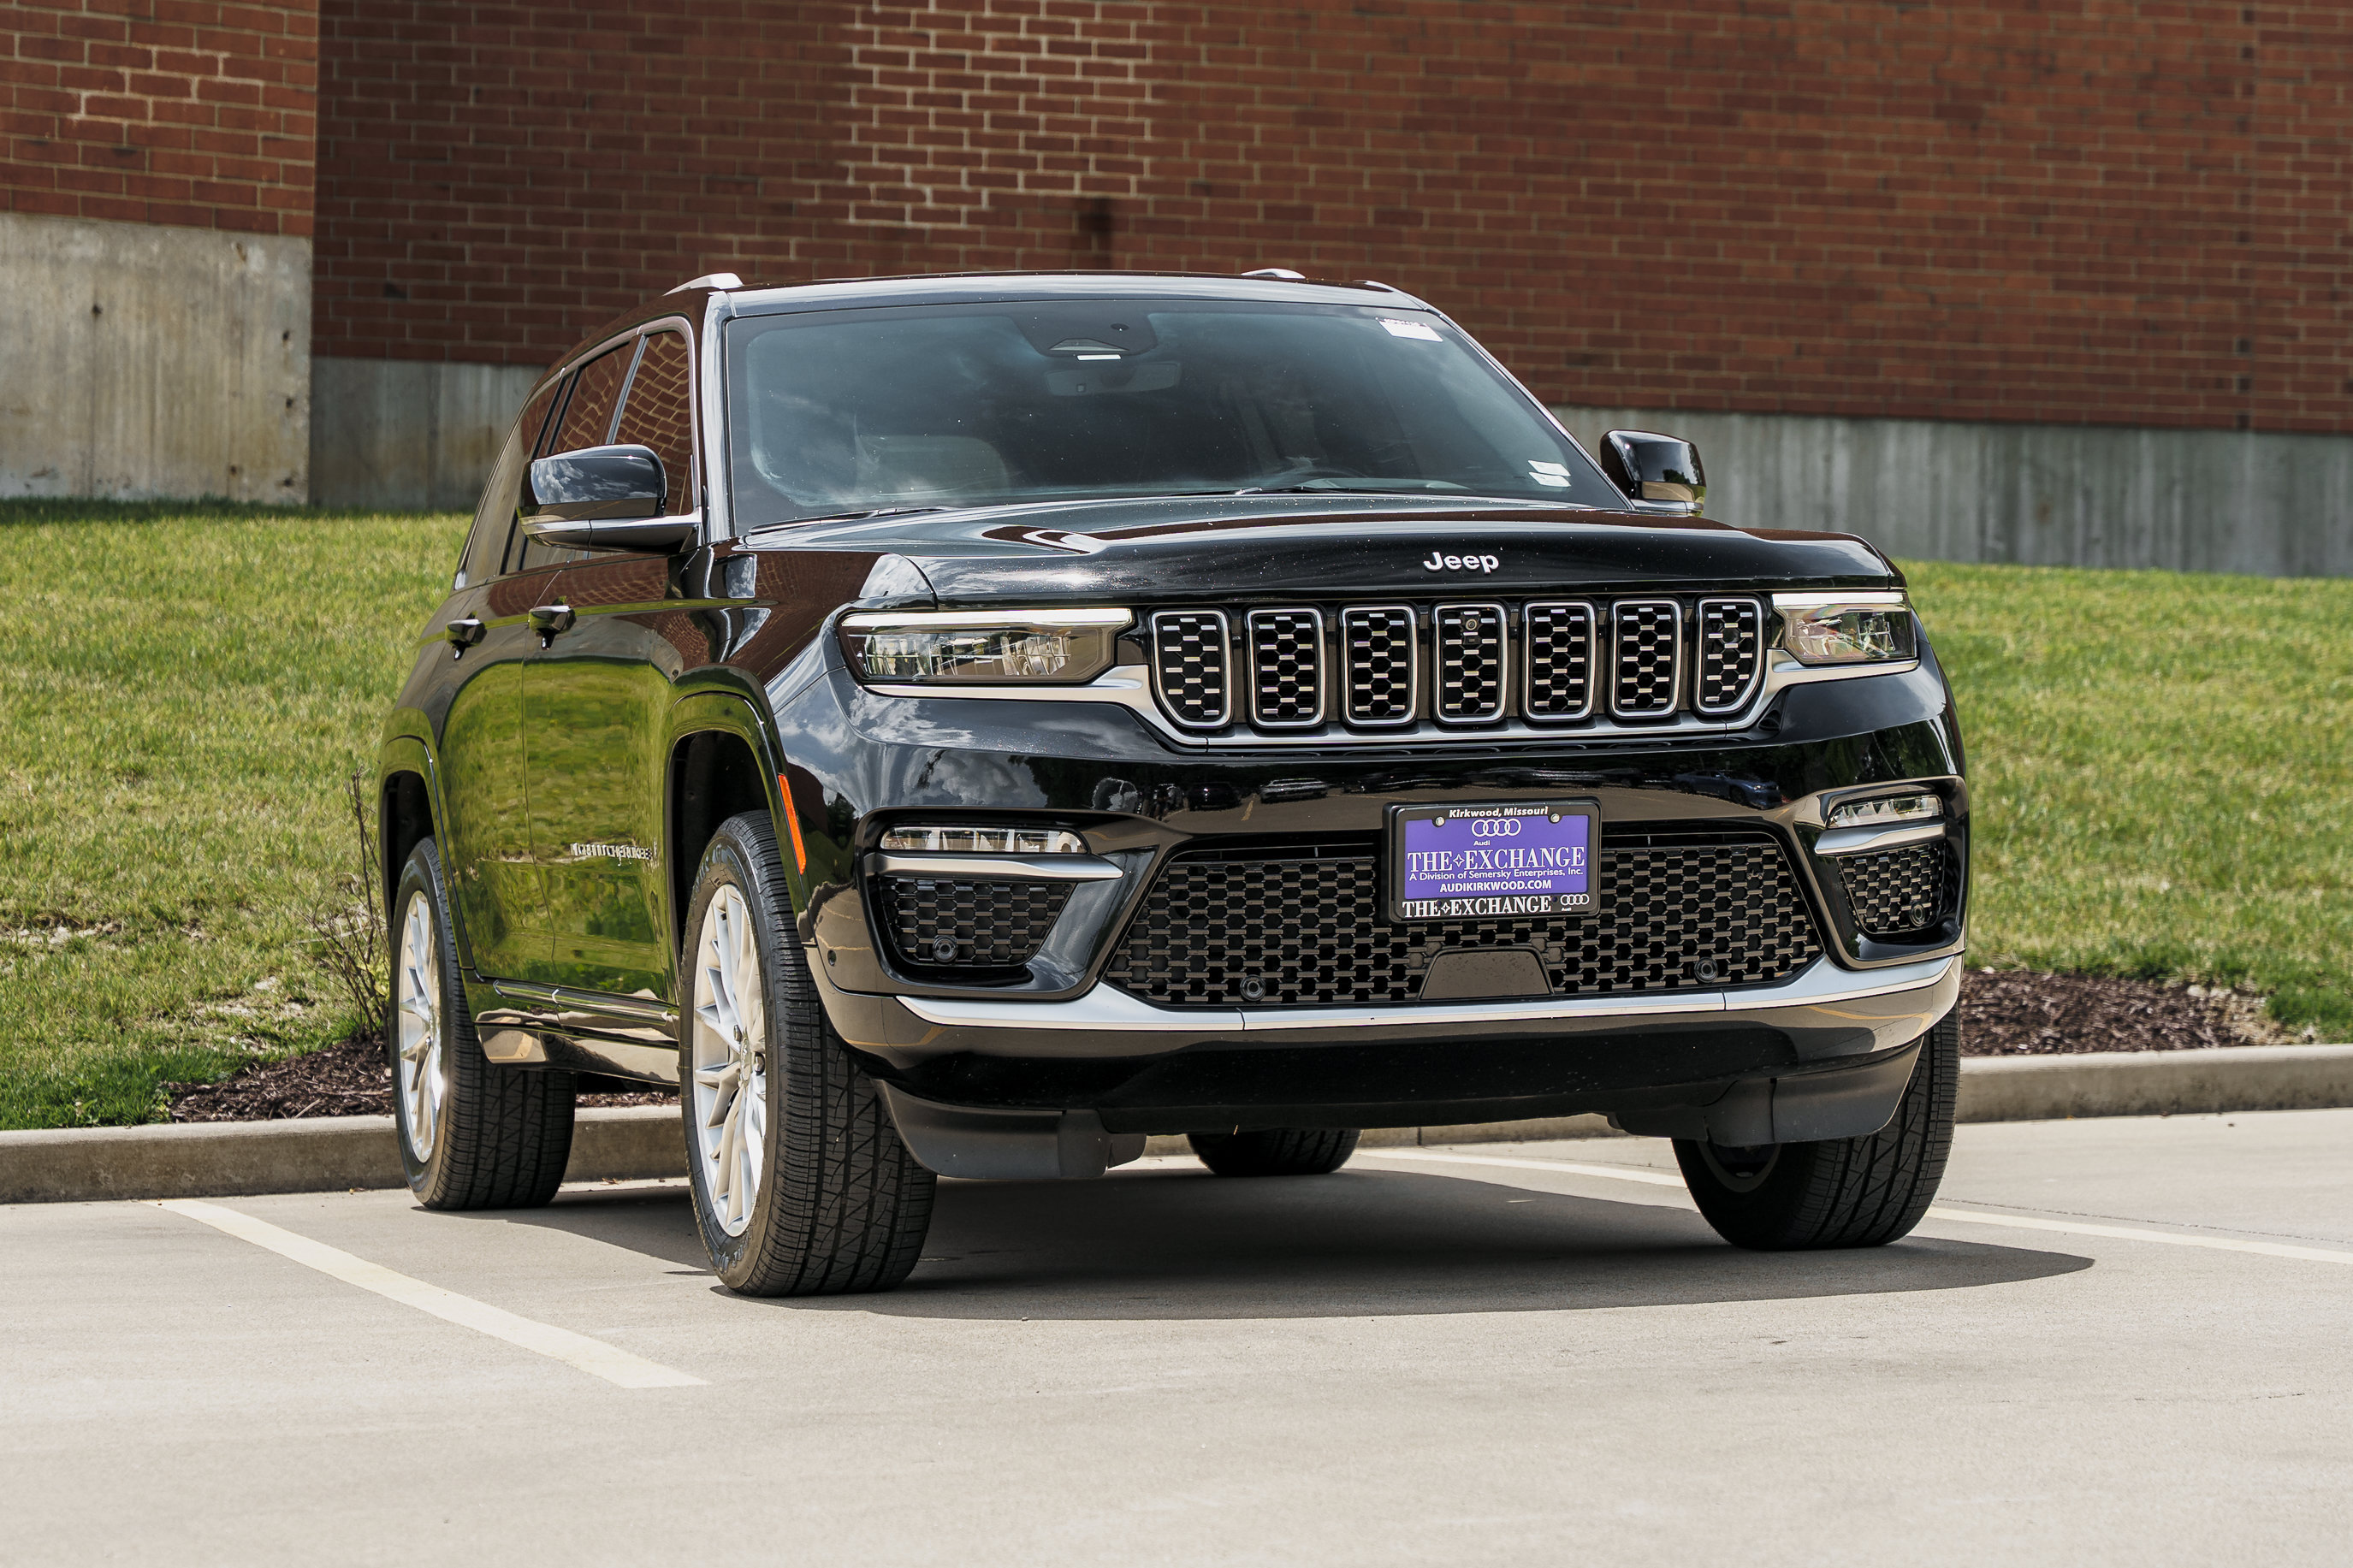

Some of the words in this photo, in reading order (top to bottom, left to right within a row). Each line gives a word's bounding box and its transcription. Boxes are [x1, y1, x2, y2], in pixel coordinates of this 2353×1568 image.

[1423, 552, 1499, 574] Jeep
[1449, 808, 1502, 819] Kirkwood,
[1503, 807, 1548, 816] Missouri
[1408, 851, 1452, 873] THE
[1464, 847, 1584, 870] EXCHANGE
[1409, 873, 1417, 881] A
[1420, 872, 1455, 880] Division
[1457, 871, 1467, 879] of
[1469, 869, 1512, 879] Semersky
[1514, 868, 1566, 879] Enterprises,
[1568, 867, 1584, 876] Inc.
[1439, 879, 1552, 893] AUDIKIRKWOOD.COM
[1402, 900, 1440, 918] THE
[1449, 896, 1552, 917] EXCHANGE
